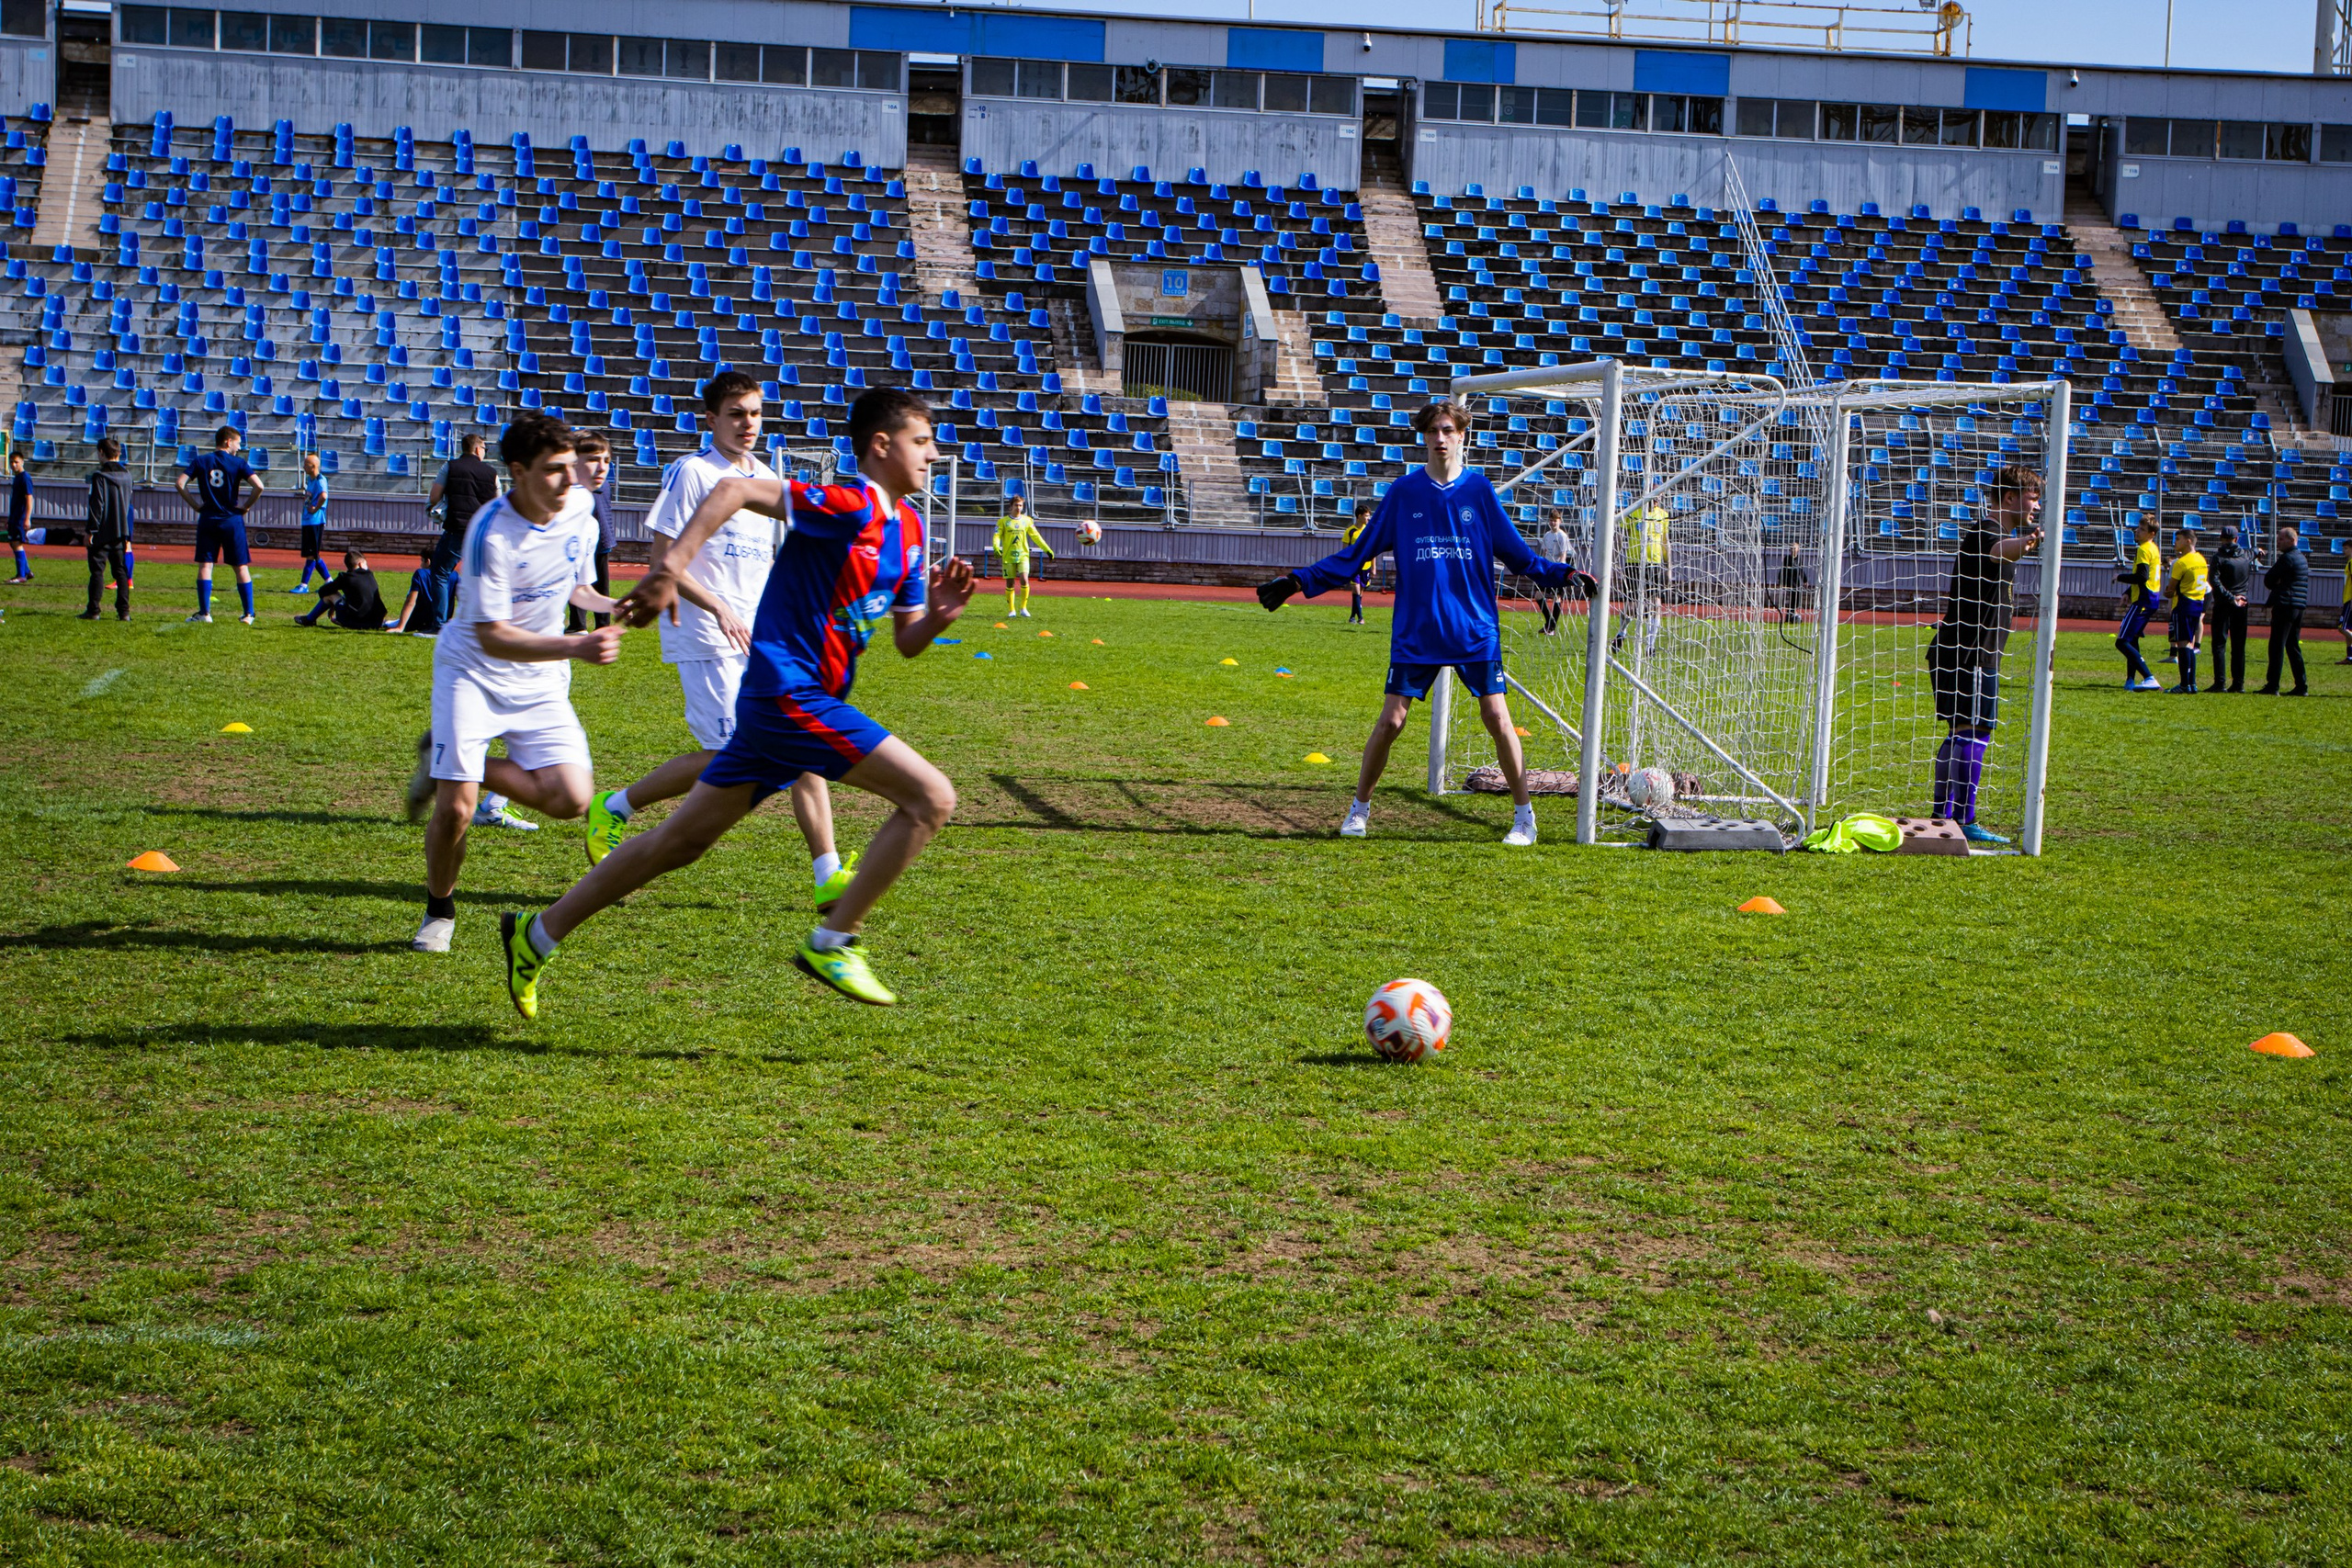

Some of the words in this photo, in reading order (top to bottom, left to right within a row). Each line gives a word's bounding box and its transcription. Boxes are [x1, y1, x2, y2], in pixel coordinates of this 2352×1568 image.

[1167, 276, 1183, 288] 10
[209, 469, 224, 488] 8
[1416, 547, 1473, 562] ДОБРЯКОВ
[2195, 574, 2206, 591] 5
[435, 742, 446, 765] 7
